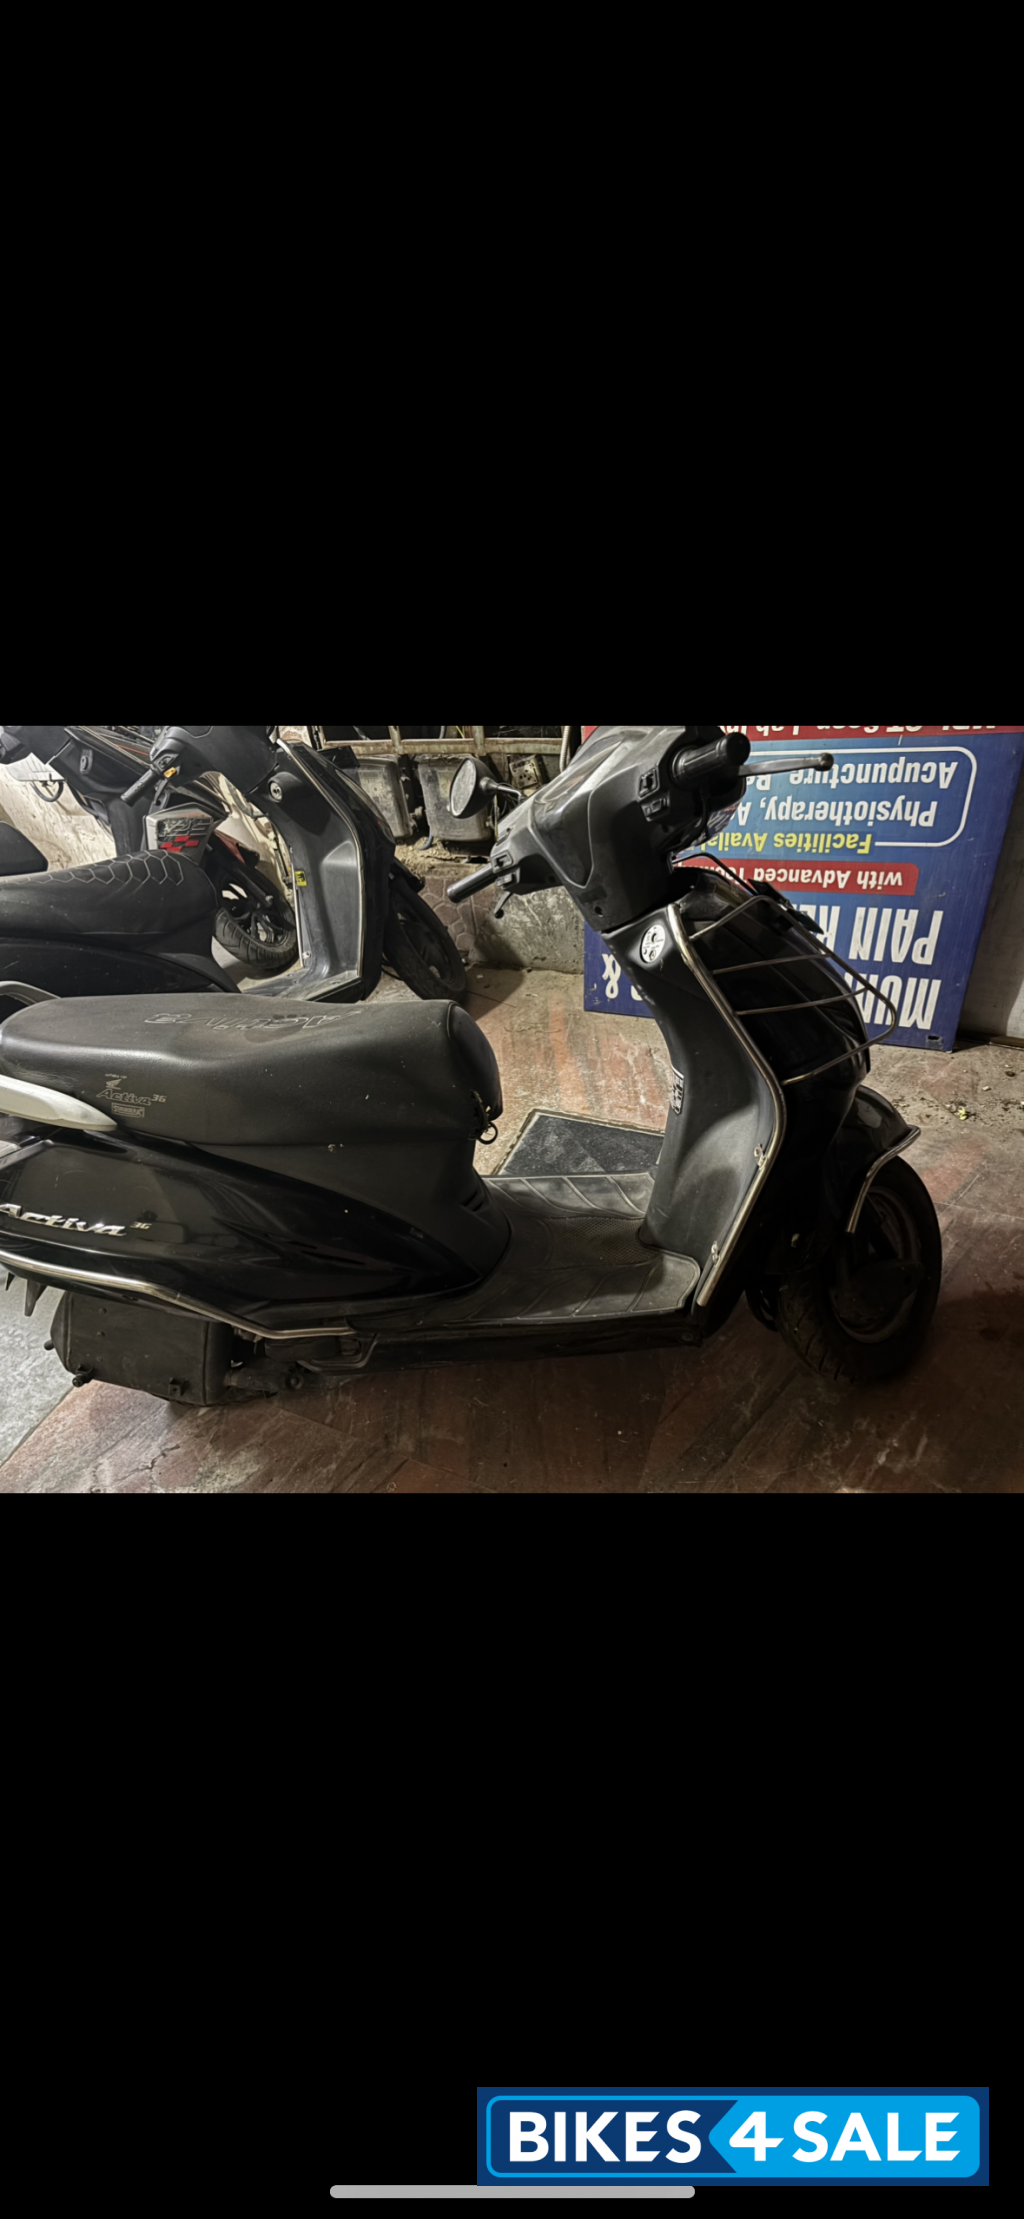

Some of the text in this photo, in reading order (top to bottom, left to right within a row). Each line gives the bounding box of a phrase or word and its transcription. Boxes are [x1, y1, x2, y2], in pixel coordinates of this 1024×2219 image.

[760, 798, 936, 827] Physiotherapy,
[701, 832, 872, 854] Facilities Availa
[753, 868, 852, 889] Advanced
[857, 871, 902, 890] with
[848, 906, 944, 965] PAIN
[844, 971, 942, 1030] MUN
[96, 1088, 168, 1106] Activa 3G
[0, 1203, 152, 1237] Activa 3G
